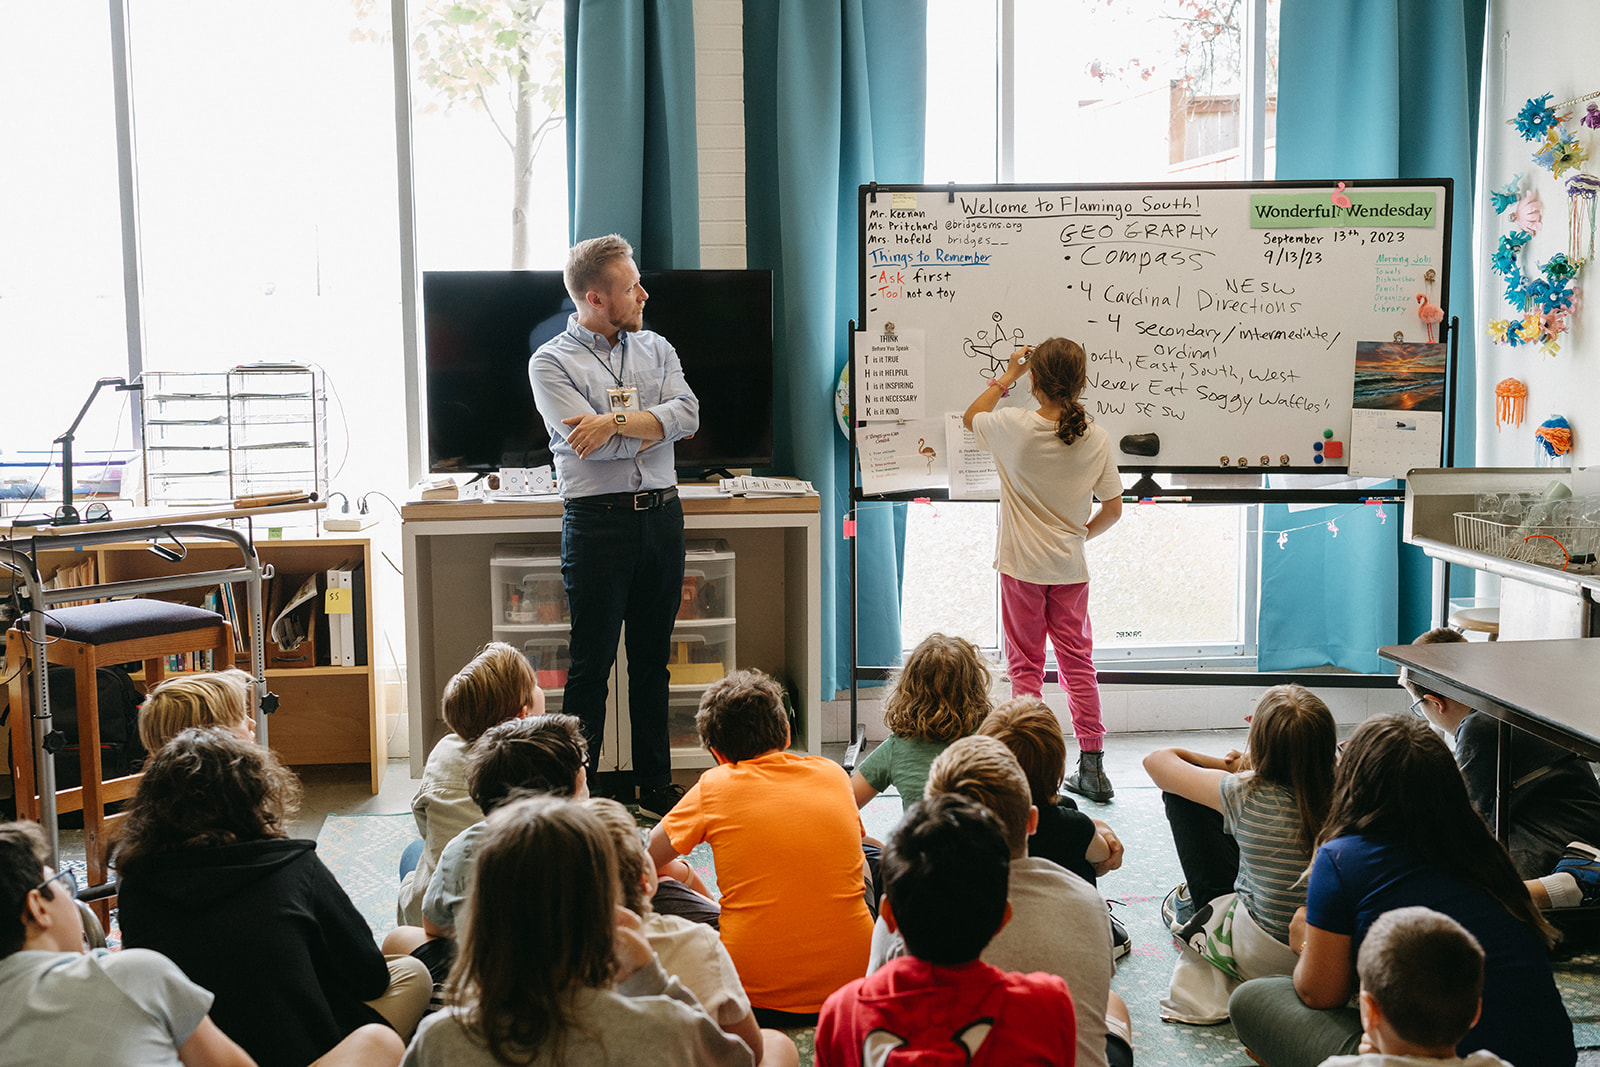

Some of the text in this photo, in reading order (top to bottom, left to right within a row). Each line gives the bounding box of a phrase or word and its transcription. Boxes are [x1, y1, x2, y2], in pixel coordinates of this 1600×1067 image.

[869, 209, 925, 218] Mr. Keenan
[960, 195, 1200, 220] Welcome to Flamingo South!
[1255, 203, 1432, 221] Wonderful Wendesday
[868, 220, 1022, 232] Ms. Pritchard @bridgesms.org
[868, 234, 889, 244] Mrs.
[896, 233, 931, 244] Hofeld
[1263, 232, 1323, 247] September
[1370, 231, 1405, 243] 2023
[869, 248, 992, 269] Things to Remember
[1080, 246, 1203, 274] Compass
[1264, 248, 1322, 269] 9/13/23
[1376, 254, 1409, 267] Morning
[879, 268, 951, 285] Ask first
[878, 286, 903, 299] Tool
[907, 288, 922, 298] not
[937, 287, 955, 303] toy
[1080, 281, 1302, 314] 4 Cardinal Directions
[1373, 304, 1406, 316] Library
[1108, 314, 1120, 332] 4
[864, 355, 869, 364] T
[885, 355, 899, 363] TRUE
[864, 369, 870, 378] H
[885, 369, 908, 377] HELPFUL
[1249, 368, 1301, 383] West
[885, 382, 914, 390] INSPIRING
[865, 395, 870, 403] N
[1149, 379, 1188, 396] Eat
[1196, 385, 1253, 415] Soggy
[866, 408, 871, 416] K
[1097, 401, 1125, 415] NW
[1135, 402, 1156, 417] SE
[1162, 406, 1185, 420] SW
